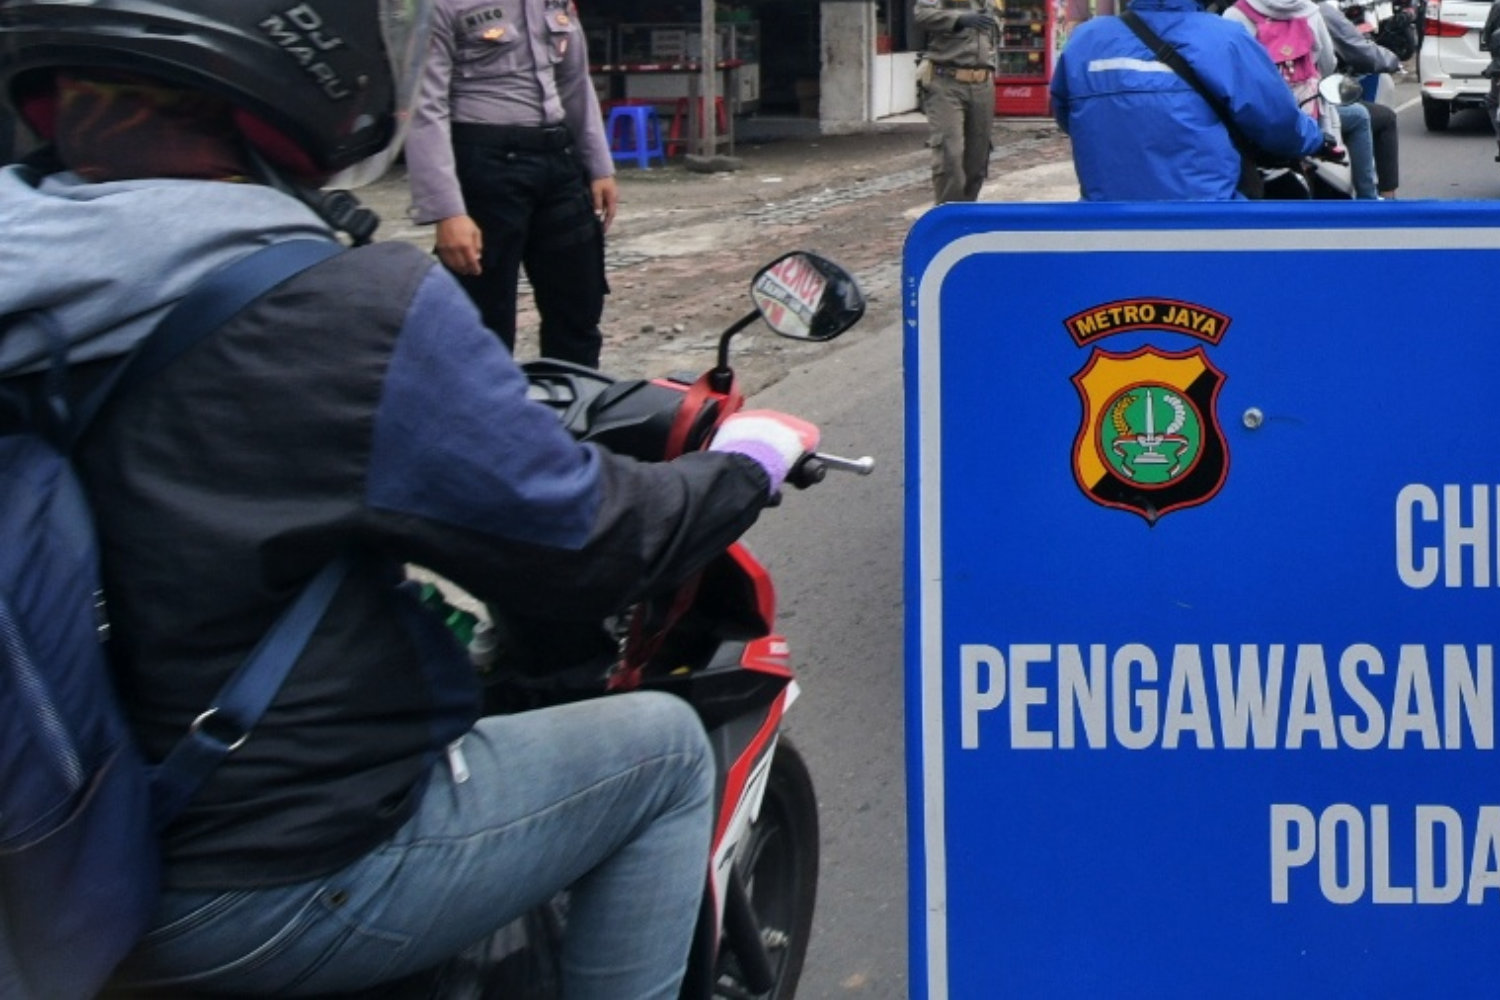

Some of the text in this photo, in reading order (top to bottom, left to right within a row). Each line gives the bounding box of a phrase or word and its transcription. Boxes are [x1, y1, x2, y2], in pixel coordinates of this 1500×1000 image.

[286, 1, 344, 51] DJ
[464, 8, 503, 28] NIKO
[260, 14, 349, 100] MARU
[1076, 304, 1217, 337] METRO JAYA
[959, 643, 1494, 751] PENGAWASAN
